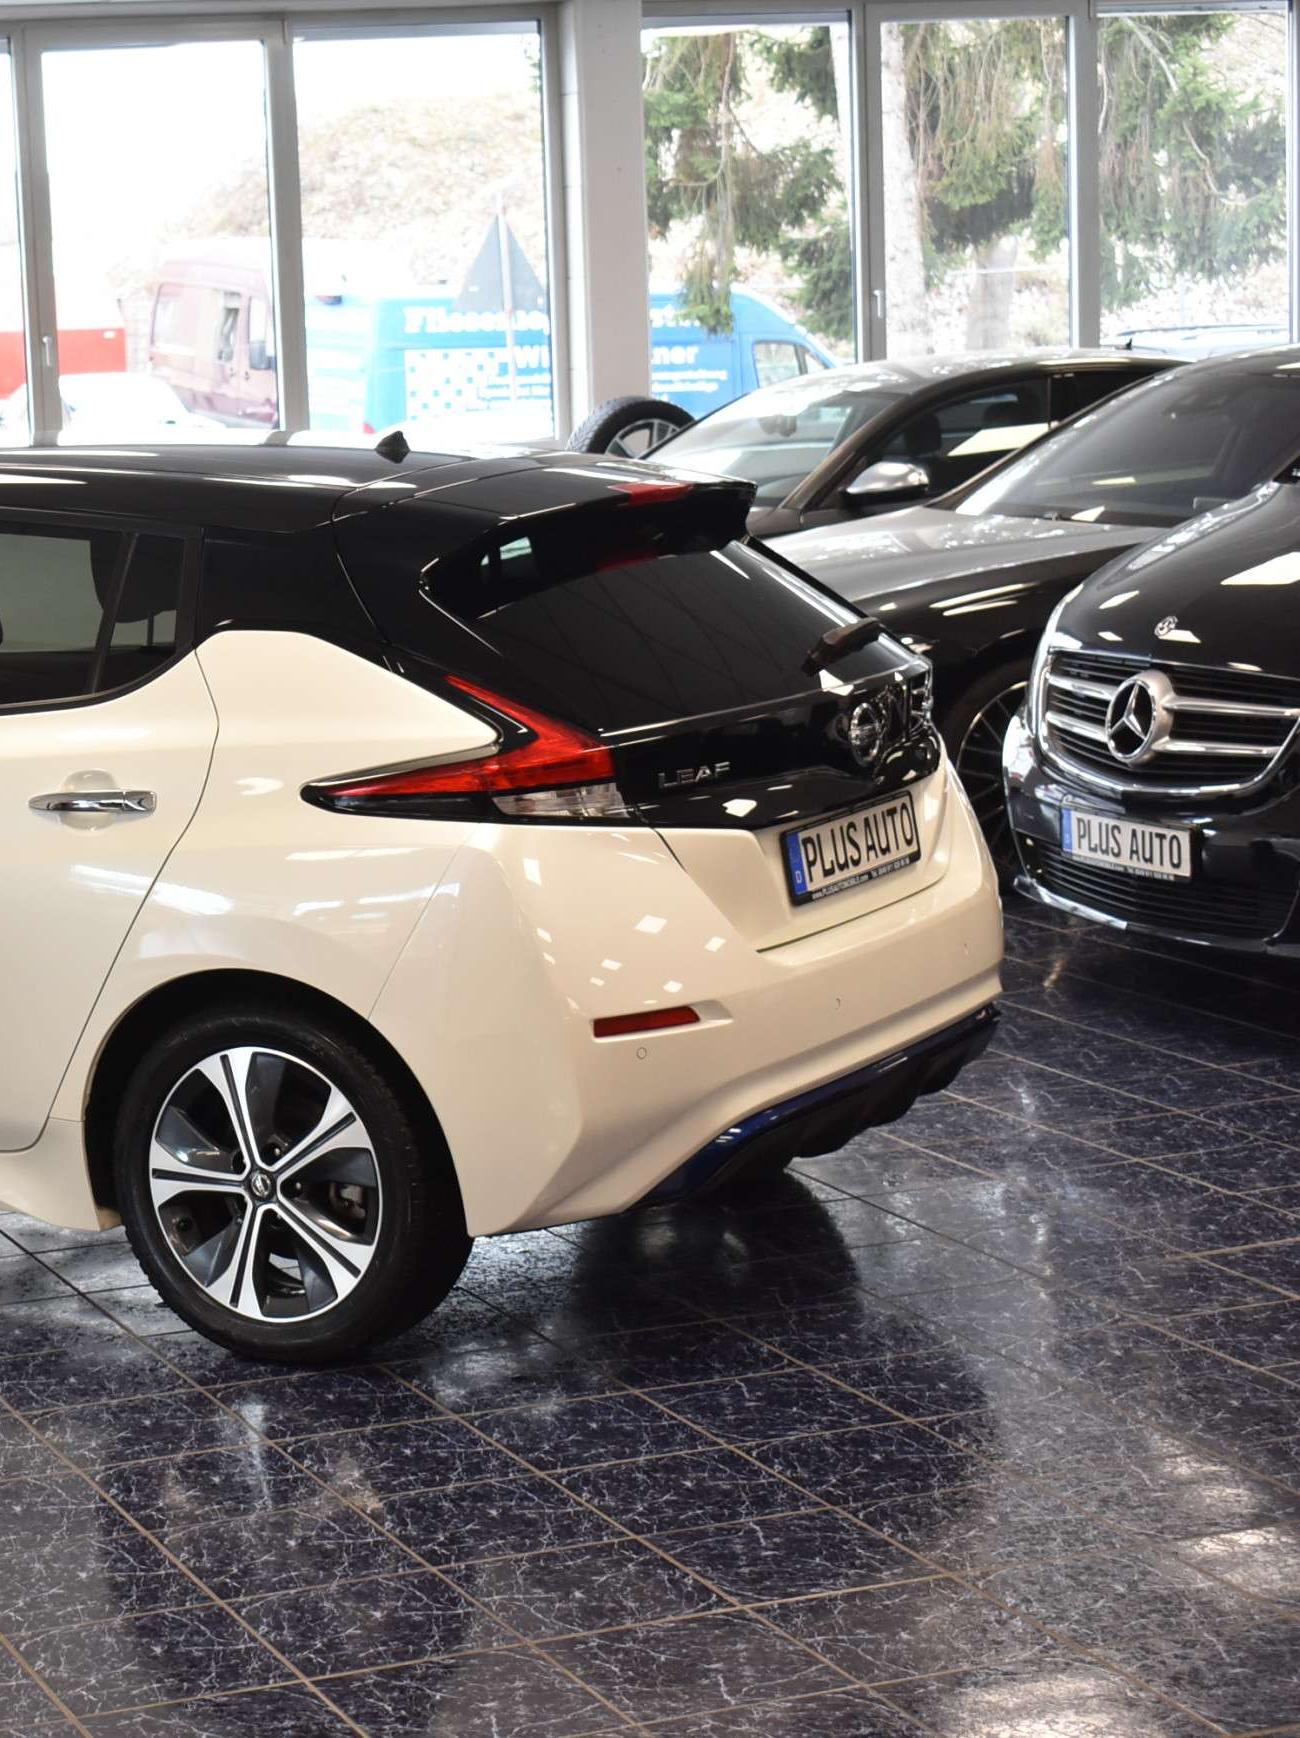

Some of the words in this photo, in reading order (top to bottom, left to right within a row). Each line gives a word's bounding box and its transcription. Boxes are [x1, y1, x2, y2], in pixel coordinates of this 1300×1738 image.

[658, 761, 731, 788] LEAF
[801, 821, 862, 882] PLUS
[863, 802, 914, 862] AUTO
[1076, 817, 1122, 858] PLUS
[1129, 829, 1182, 870] AUTO
